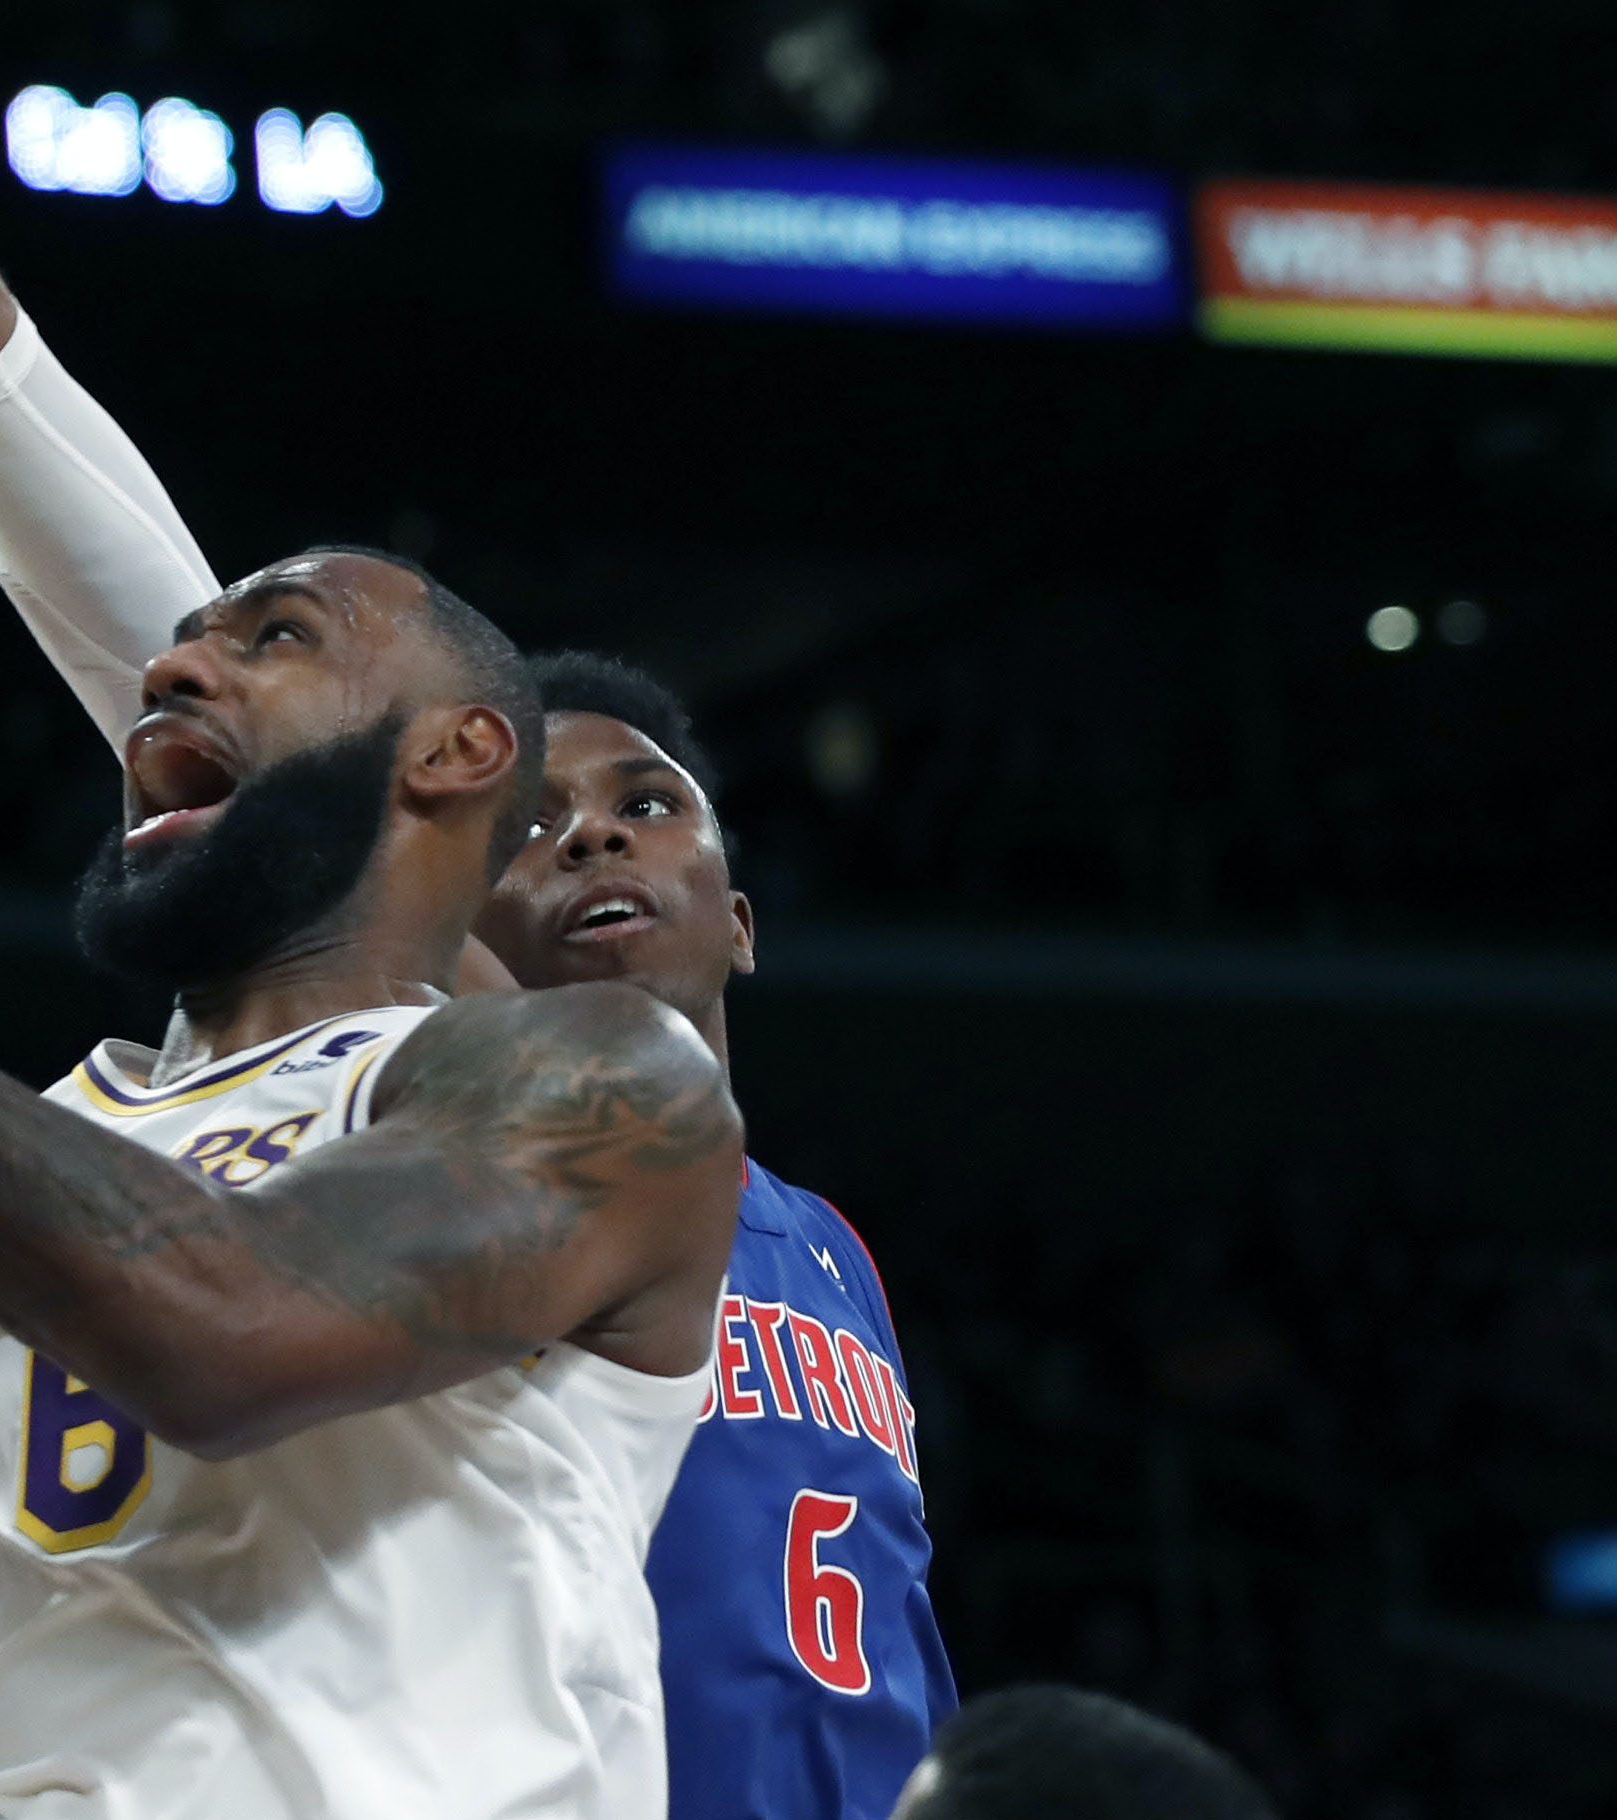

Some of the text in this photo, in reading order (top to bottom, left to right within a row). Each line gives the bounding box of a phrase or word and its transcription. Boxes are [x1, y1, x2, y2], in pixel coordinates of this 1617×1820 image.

[17, 1348, 154, 1555] 6
[695, 1294, 920, 1484] ETROI
[784, 1487, 872, 1696] 6
